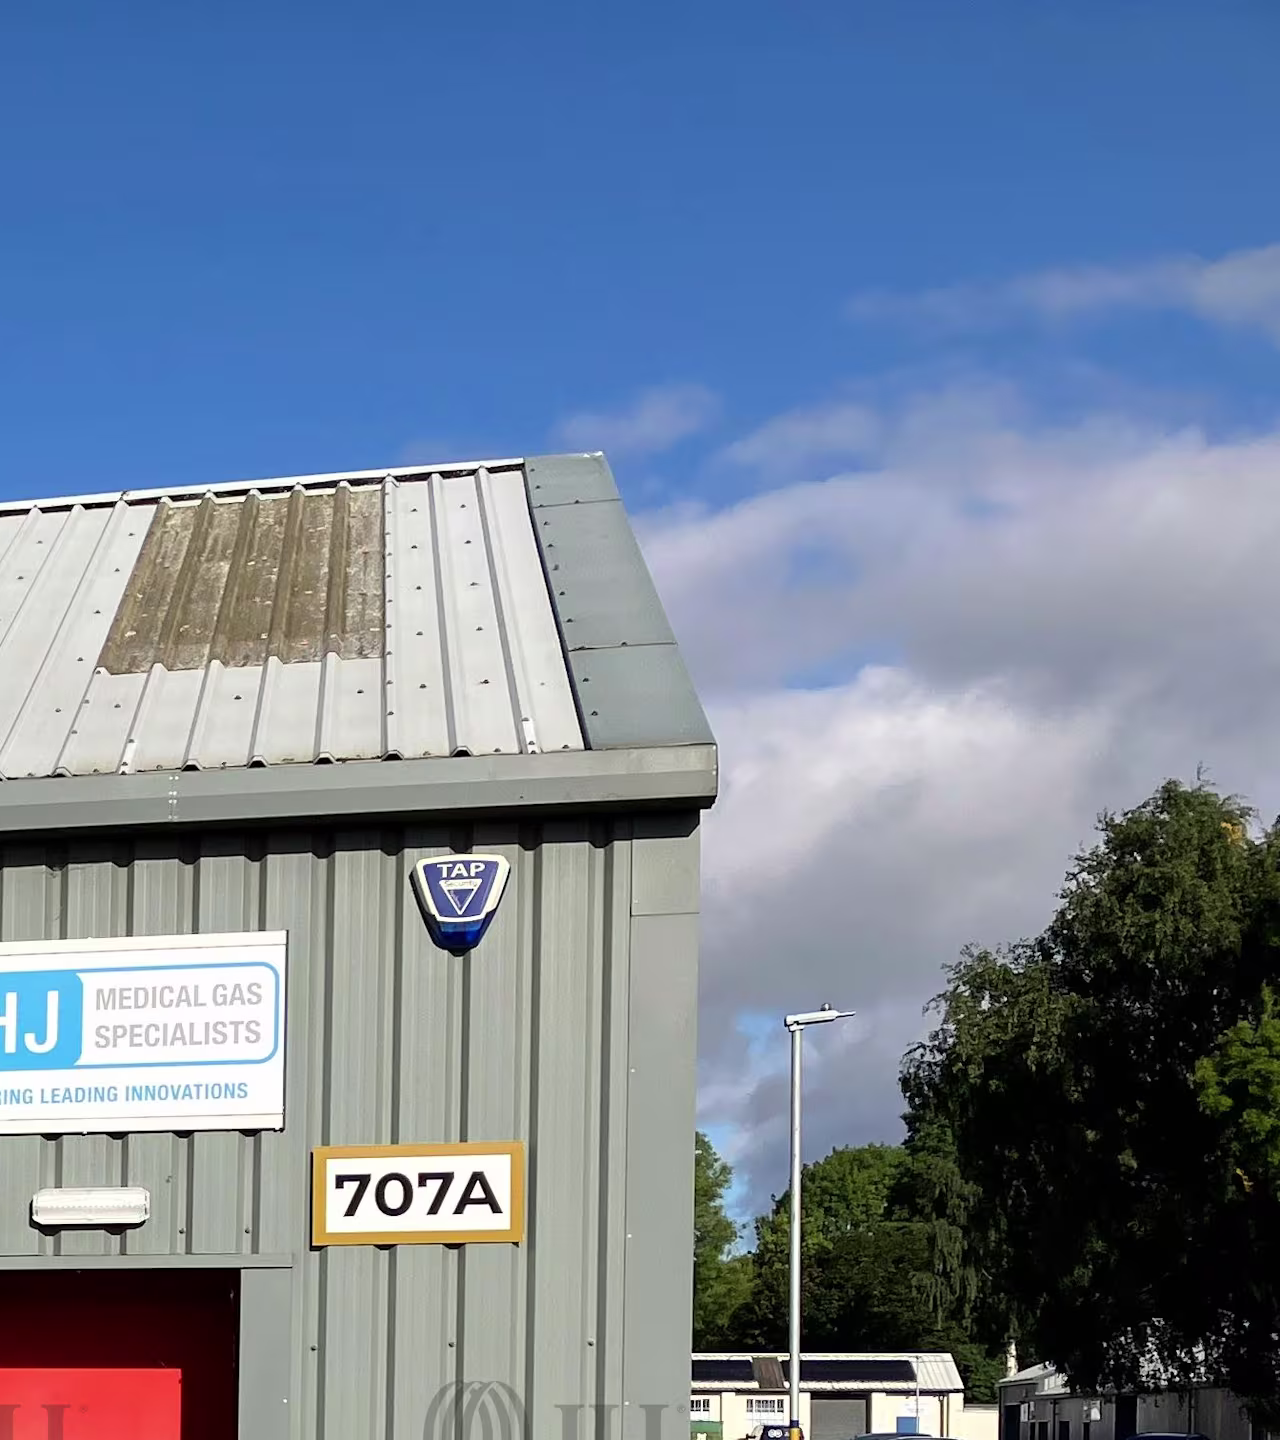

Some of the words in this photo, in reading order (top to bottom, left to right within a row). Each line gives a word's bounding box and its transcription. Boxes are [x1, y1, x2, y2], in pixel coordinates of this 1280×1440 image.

[436, 862, 486, 878] TAP
[95, 984, 206, 1010] MEDICAL
[212, 982, 262, 1006] GAS
[95, 1020, 262, 1049] SPECIALISTS
[40, 1085, 118, 1104] LEADING
[125, 1082, 248, 1102] INNOVATIONS
[334, 1171, 503, 1217] 707A
